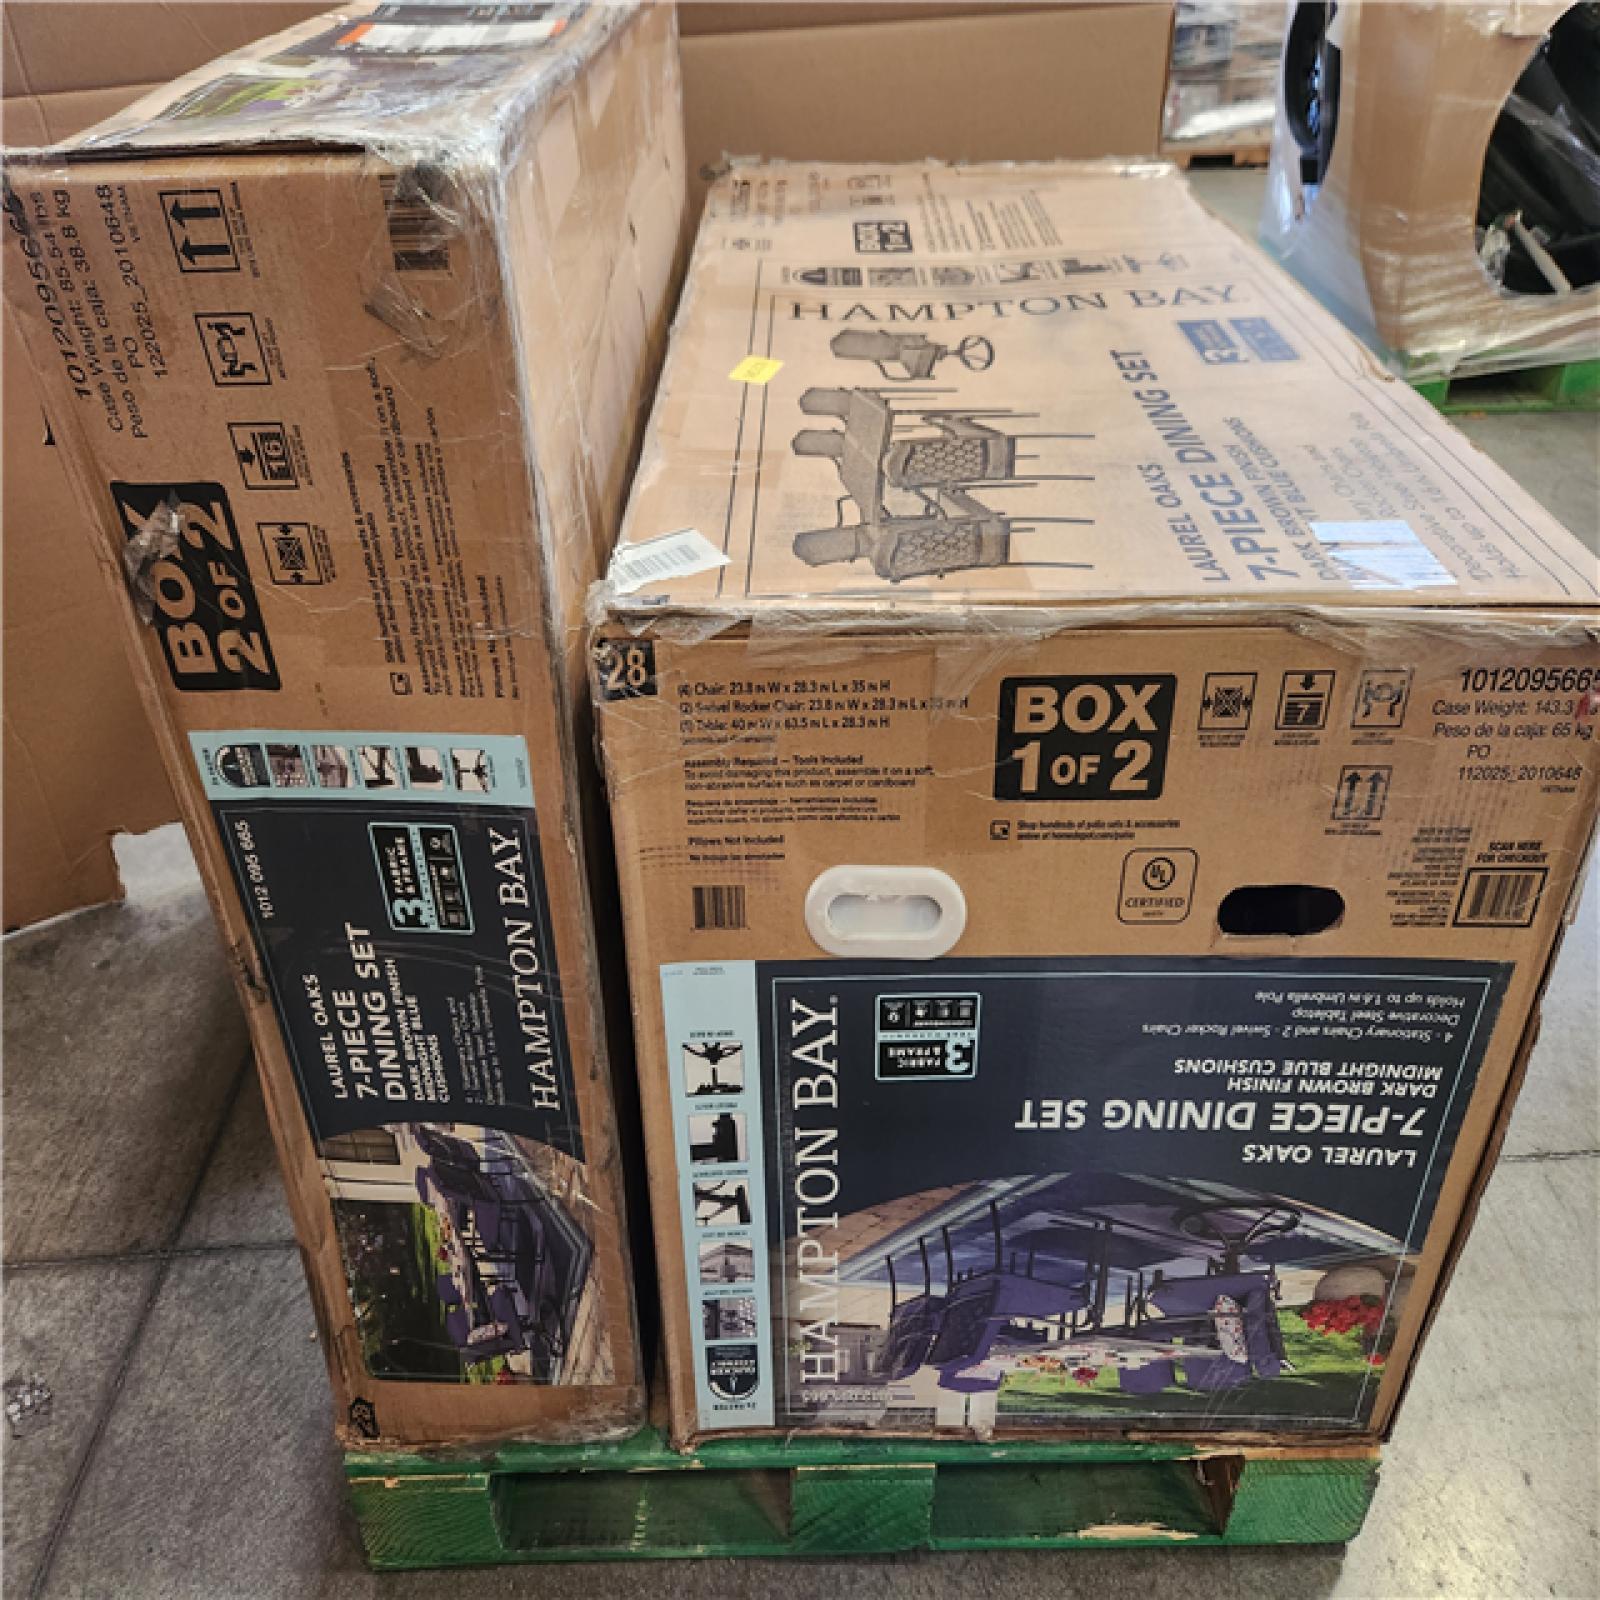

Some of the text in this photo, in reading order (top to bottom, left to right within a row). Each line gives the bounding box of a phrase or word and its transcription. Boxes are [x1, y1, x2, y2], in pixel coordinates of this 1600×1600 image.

[53, 190, 73, 218] kg
[44, 232, 75, 292] 85.54
[61, 225, 91, 273] 38.8
[84, 280, 109, 328] caja:
[789, 284, 1235, 320] HAMPTON BAY
[67, 300, 103, 376] Weight:
[122, 336, 145, 369] PO
[109, 359, 128, 383] de
[99, 382, 123, 433] Case
[122, 390, 148, 439] Peso
[265, 440, 286, 472] 16
[1110, 350, 1300, 581] 7-PIECE DINING SET
[374, 464, 394, 522] Included
[1266, 471, 1307, 503] BLUE
[1137, 465, 1230, 582] LAUREL OAKS
[1253, 484, 1306, 537] BROWN
[391, 527, 404, 560] Tools
[1290, 543, 1340, 580] DARK
[177, 501, 270, 673] 2 OF 2
[730, 681, 753, 695] 23.8
[1014, 683, 1162, 734] BOX
[1297, 704, 1310, 723] 7
[1433, 700, 1470, 715] Case
[1475, 700, 1528, 717] Weight:
[1536, 700, 1573, 715] 143.3
[1433, 722, 1593, 740] Peso de la caja: 65 kg
[820, 754, 863, 765] Included
[1011, 739, 1153, 793] 1 OF 2
[1467, 745, 1491, 760] PO
[744, 834, 785, 845] Included
[234, 819, 276, 919] 1012 095 665
[1150, 864, 1167, 884] UL
[1475, 853, 1496, 863] FOR
[392, 899, 434, 925] 3
[1125, 896, 1186, 908] CERTIFIED
[488, 827, 561, 1112] HAMPTON BAY
[344, 921, 408, 1101] DINING SET
[1255, 990, 1283, 1003] Pole
[1287, 991, 1346, 1003] Umbrella
[384, 959, 425, 1101] DARK BROWN FINISH
[1142, 1023, 1182, 1035] Chairs
[1282, 1025, 1292, 1037] 2
[1292, 1007, 1460, 1026] Decorative Steel Tabletop
[1294, 1025, 1320, 1038] and
[1322, 1026, 1362, 1039] Chairs
[301, 974, 348, 1098] LAUREL OAKS
[332, 990, 379, 1099] 7-PIECE
[404, 994, 436, 1101] MIDNIGHT BLUE
[1367, 1025, 1432, 1043] Stationary
[426, 1034, 450, 1103] CUSHIONS
[945, 1039, 971, 1073] 3
[1174, 1058, 1443, 1080] MIDNIGHT BLUE CUSHIONS
[1227, 1077, 1437, 1098] DARK BROWN FINISH
[1014, 1099, 1427, 1136] 7-PIECE DINING SET
[1242, 1144, 1417, 1168] LAUREL OAKS
[791, 997, 840, 1384] HAMPTON BAY
